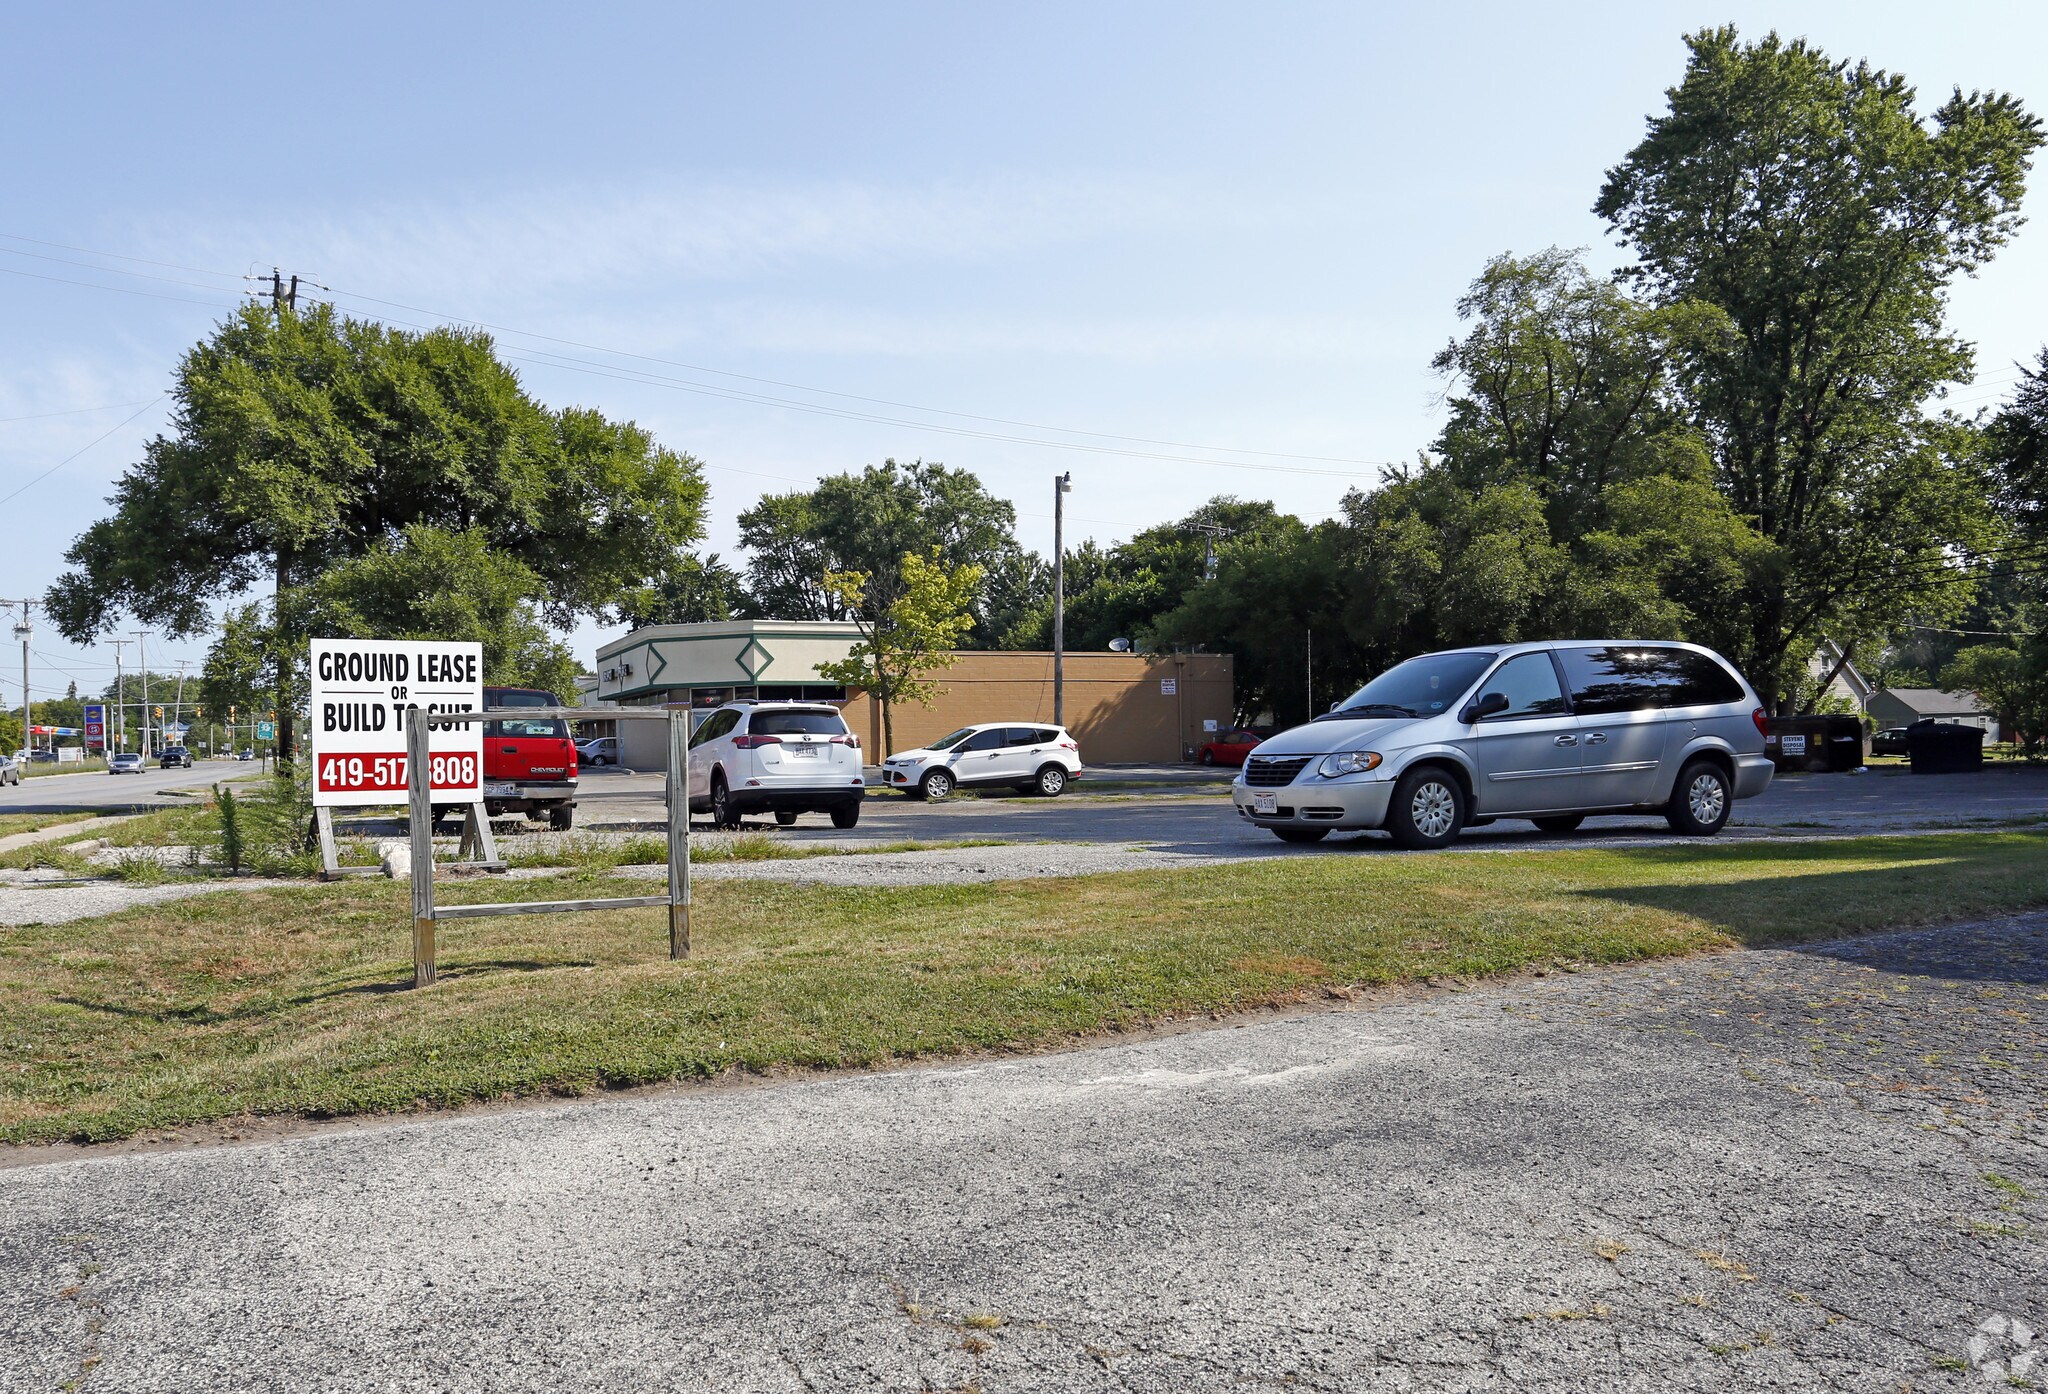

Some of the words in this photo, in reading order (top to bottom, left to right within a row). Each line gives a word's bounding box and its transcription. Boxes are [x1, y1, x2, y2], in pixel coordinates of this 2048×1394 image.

[318, 652, 409, 682] GROUND
[417, 654, 477, 683] LEASE
[391, 686, 408, 700] OR
[323, 703, 386, 732] BUILD
[393, 703, 419, 732] T
[321, 756, 475, 787] 419-517808
